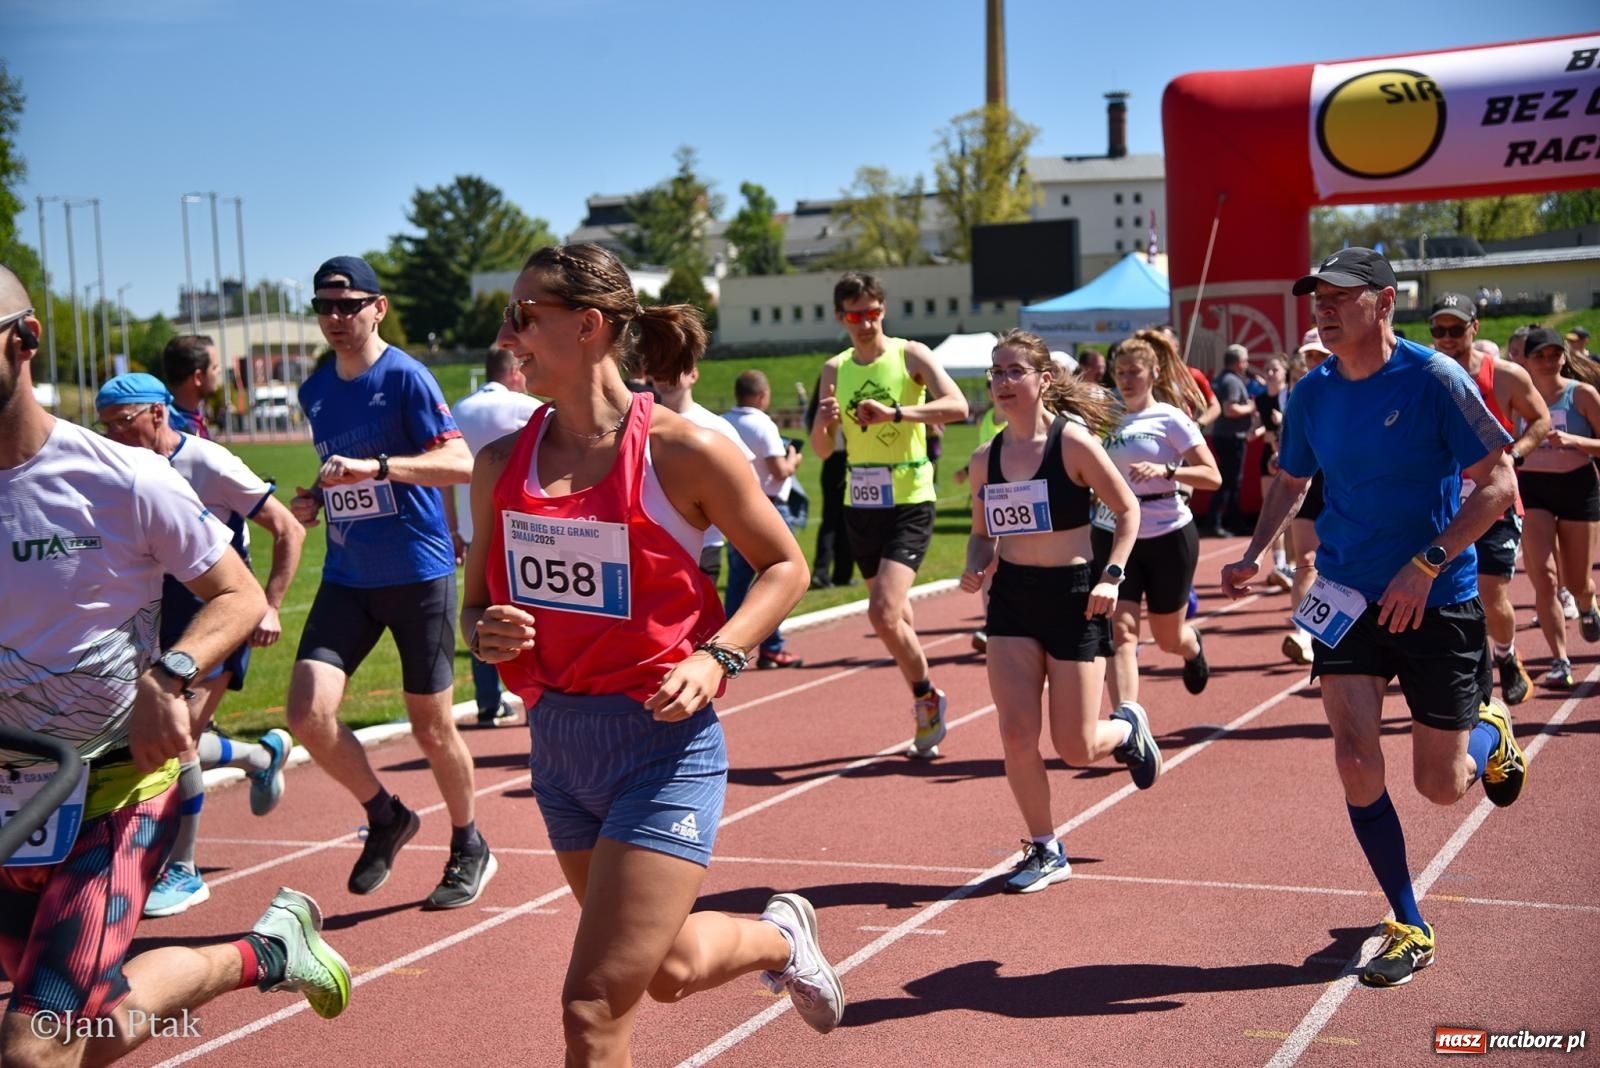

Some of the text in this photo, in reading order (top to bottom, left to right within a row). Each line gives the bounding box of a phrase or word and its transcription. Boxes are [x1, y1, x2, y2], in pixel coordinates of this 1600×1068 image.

[1565, 48, 1600, 72] B
[1481, 89, 1579, 126] BEZ
[331, 489, 373, 511] 065
[853, 486, 879, 501] 069
[993, 505, 1031, 526] 038
[511, 520, 599, 538] XVIII BIEG BEZ GRANIC
[12, 534, 98, 562] UTA TEAM
[520, 556, 596, 597] 058
[1300, 593, 1331, 624] 079
[671, 822, 701, 841] PEAK
